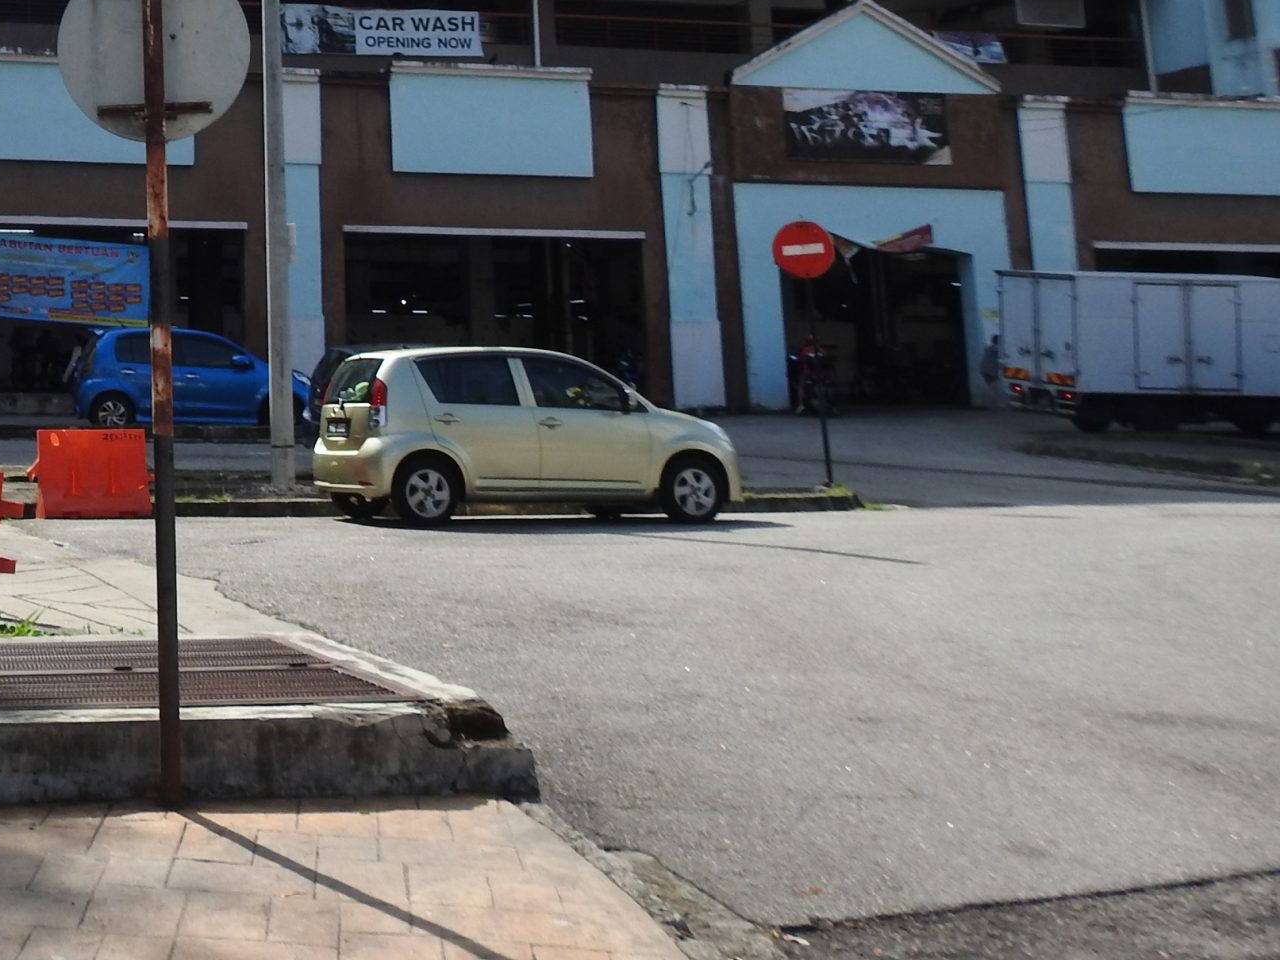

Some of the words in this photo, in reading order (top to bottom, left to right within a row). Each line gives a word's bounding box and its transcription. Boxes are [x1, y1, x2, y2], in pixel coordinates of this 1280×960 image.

[358, 16, 405, 32] CAR
[412, 16, 475, 32] WASH
[365, 36, 432, 49] OPENING
[437, 37, 472, 49] NOW
[58, 244, 120, 258] BERTUAH
